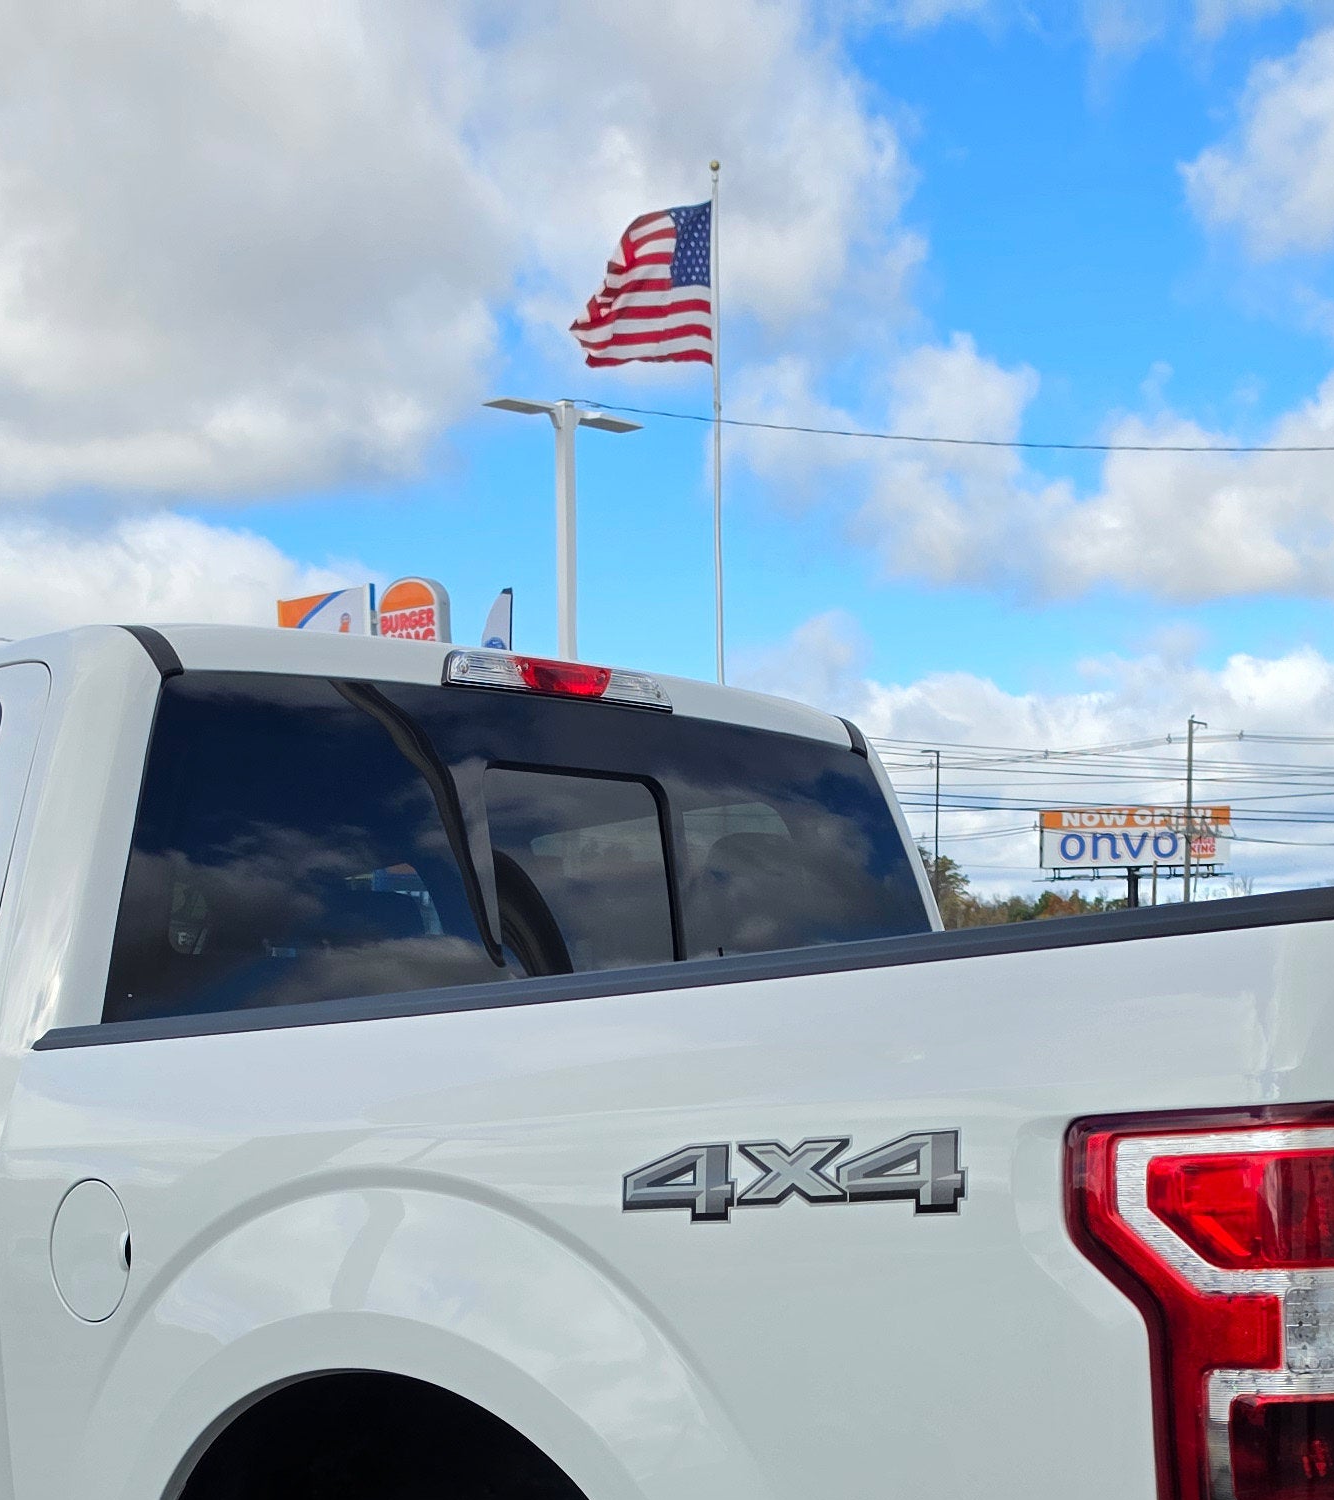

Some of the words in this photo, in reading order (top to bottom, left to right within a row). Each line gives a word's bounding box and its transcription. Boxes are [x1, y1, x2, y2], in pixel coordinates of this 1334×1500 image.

[380, 608, 436, 635] BURGER
[1061, 809, 1129, 827] NOW
[1060, 831, 1178, 861] onvo
